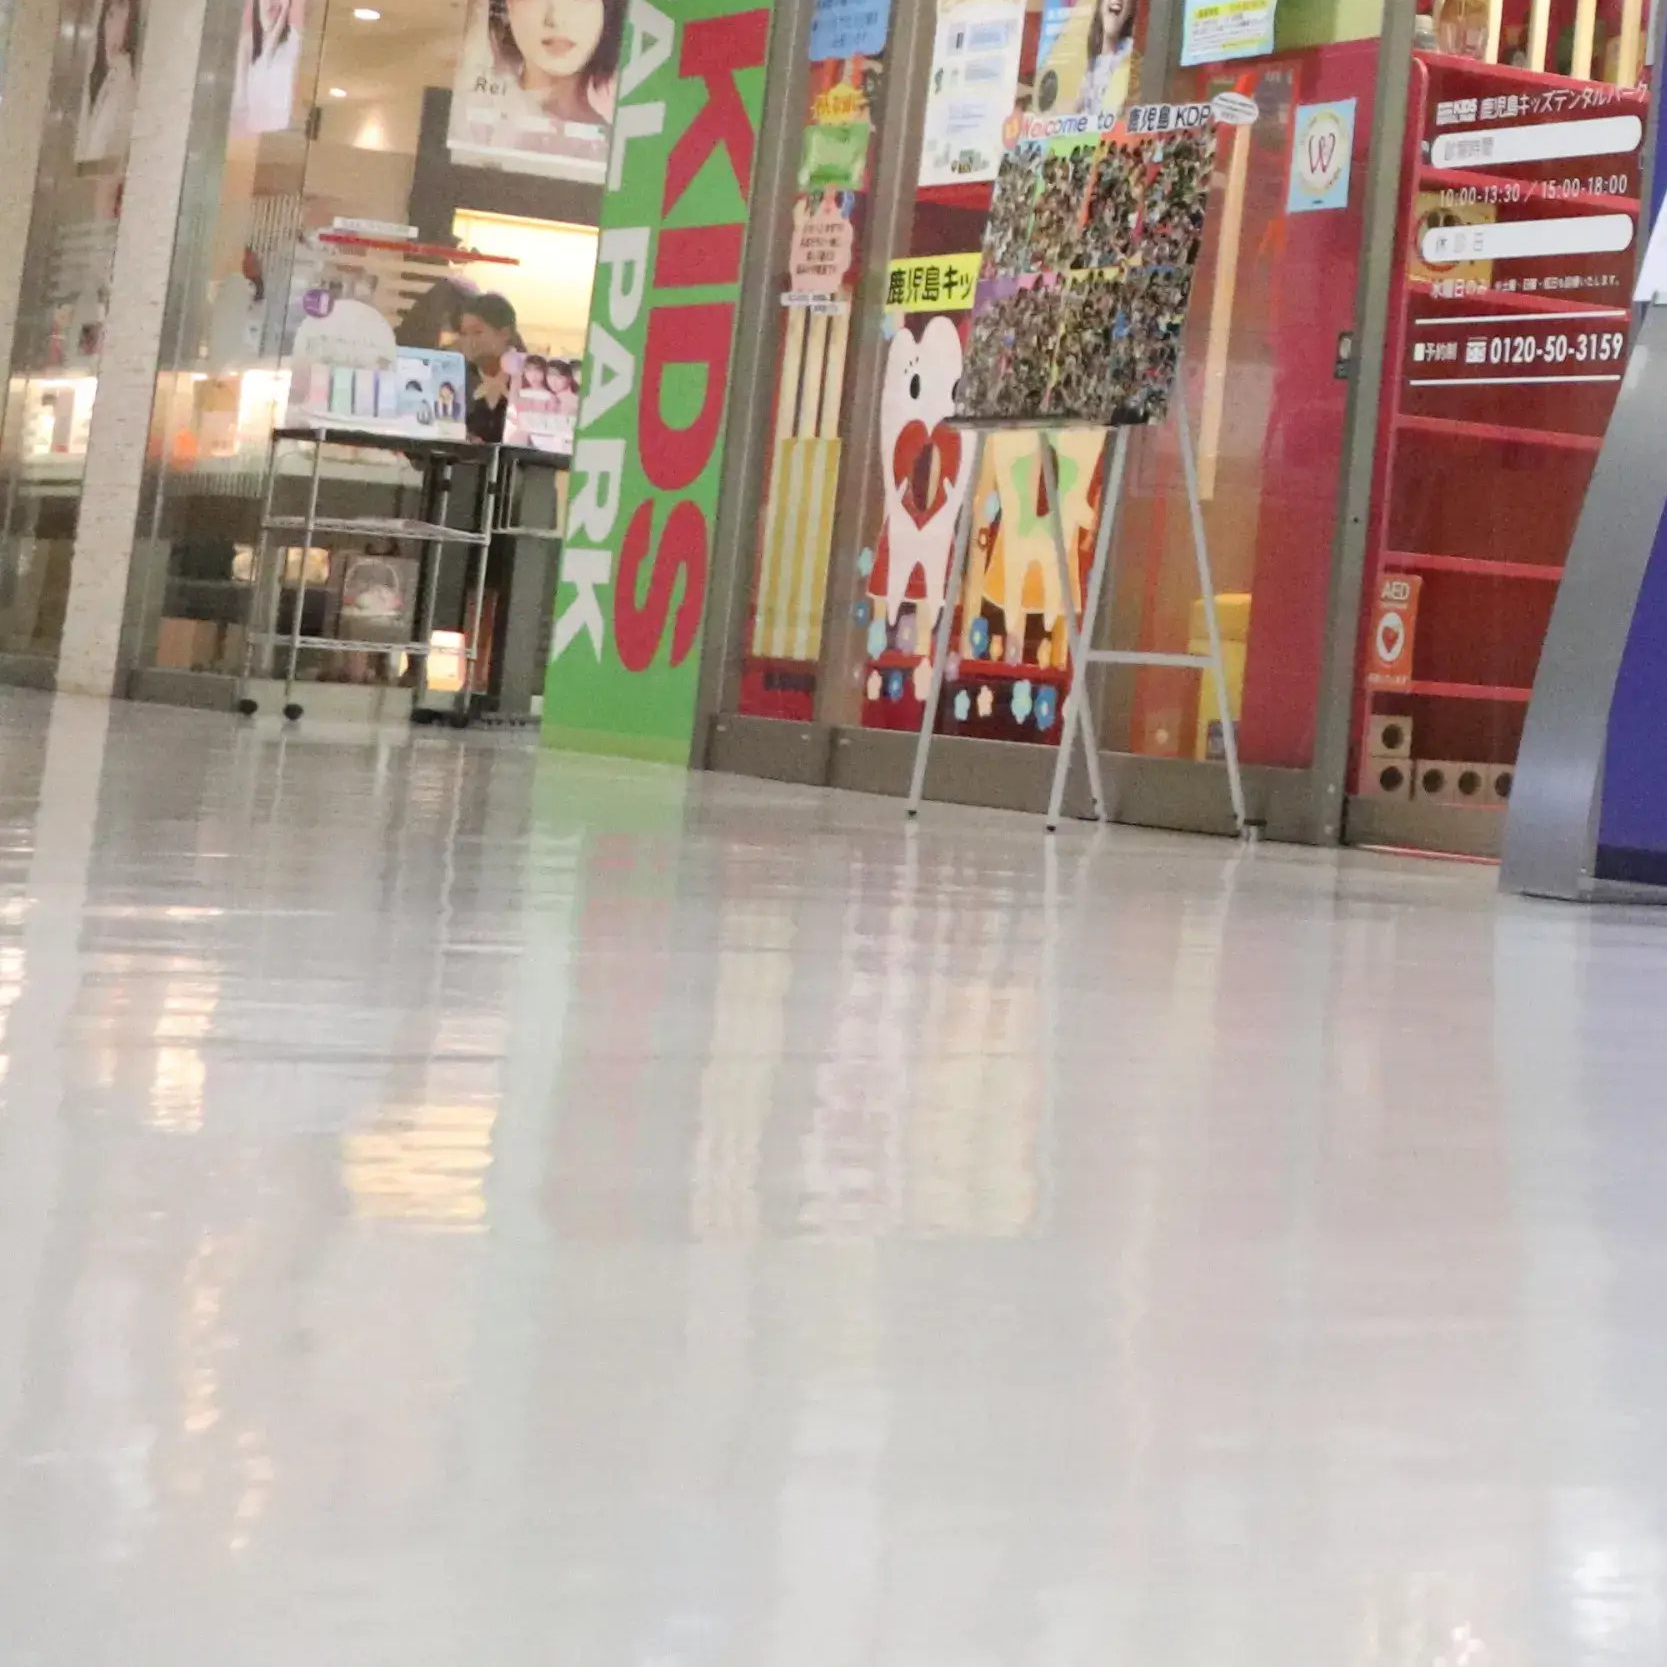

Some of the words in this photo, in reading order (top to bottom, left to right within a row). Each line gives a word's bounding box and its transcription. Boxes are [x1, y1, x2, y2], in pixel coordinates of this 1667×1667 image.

[474, 75, 506, 96] Rei
[1019, 115, 1088, 138] Welcome
[1096, 112, 1115, 130] to
[1126, 107, 1170, 133] 鹿児島
[614, 7, 770, 674] KIDS
[1490, 332, 1624, 364] 0120-50-3159
[552, 226, 650, 665] PARK
[1380, 580, 1410, 601] AED
